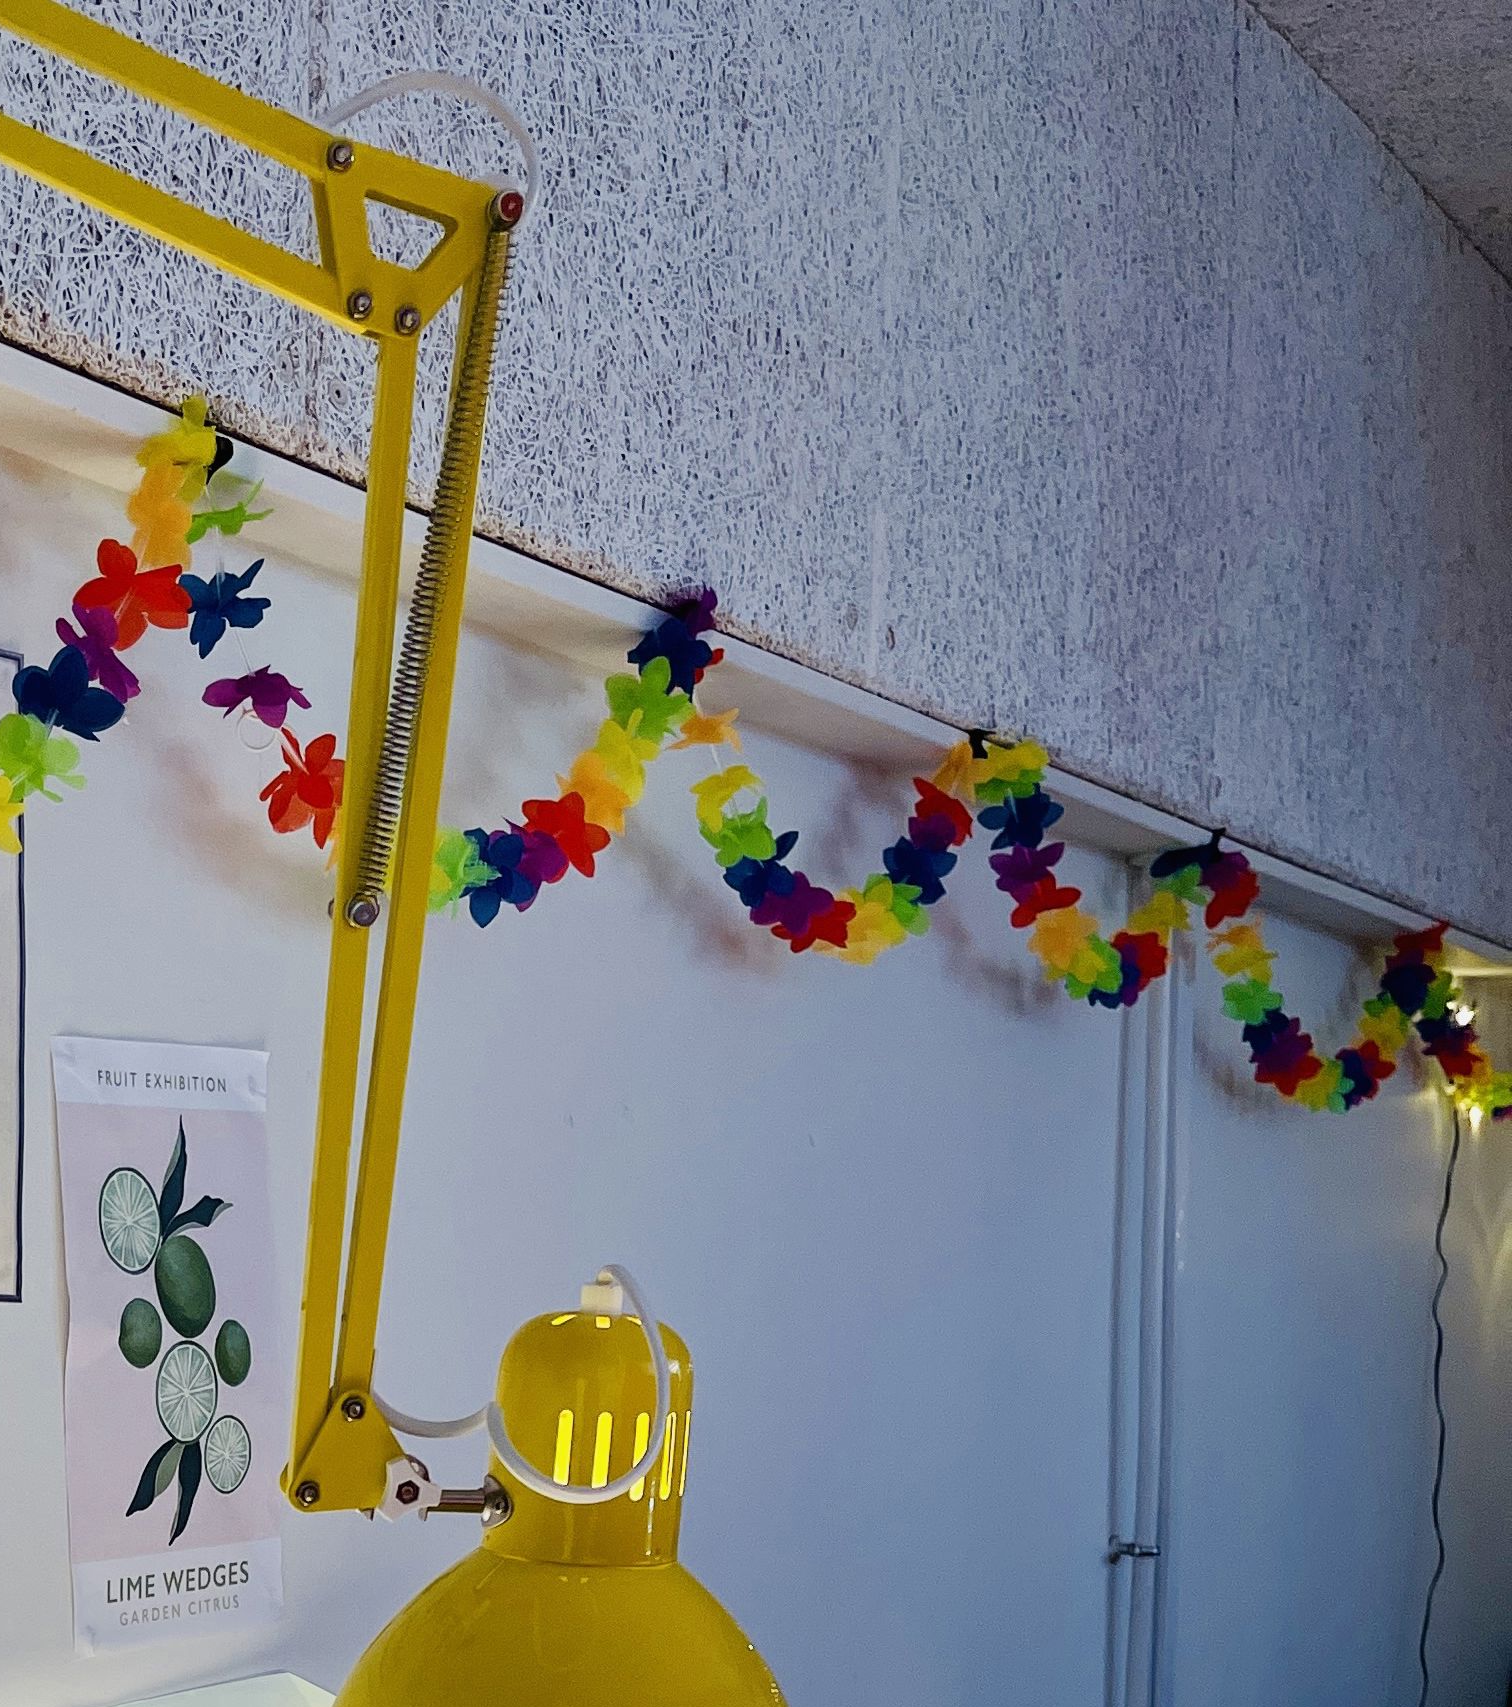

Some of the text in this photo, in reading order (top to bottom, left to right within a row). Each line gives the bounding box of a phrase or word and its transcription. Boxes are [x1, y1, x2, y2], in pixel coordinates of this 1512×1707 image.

[97, 1069, 228, 1093] FRUIT EXHIBITION
[106, 1560, 250, 1604] LIME WEDGES
[119, 1594, 240, 1627] GARDEN CITRUS
